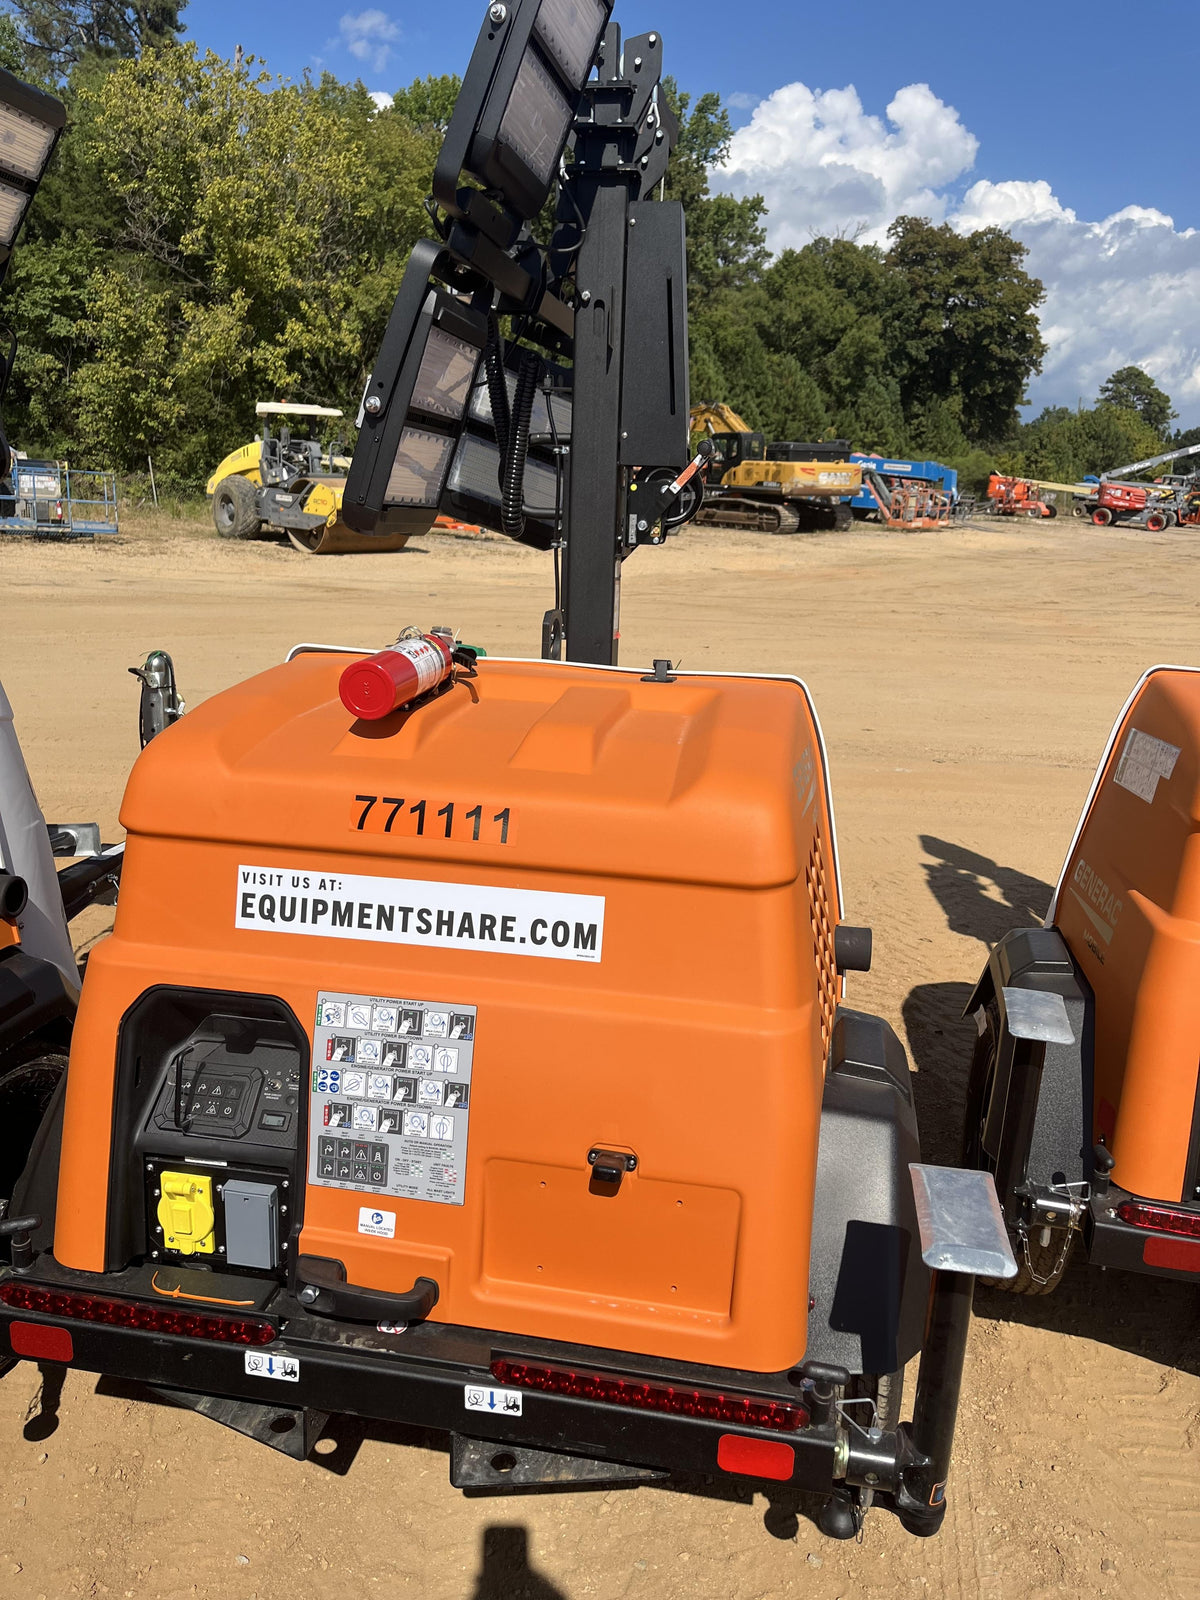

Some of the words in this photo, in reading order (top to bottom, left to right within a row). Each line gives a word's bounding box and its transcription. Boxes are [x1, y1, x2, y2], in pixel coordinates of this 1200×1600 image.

[355, 795, 511, 844] 771111
[242, 871, 284, 888] VISIT
[291, 875, 311, 890] US
[318, 878, 343, 892] AT:
[1074, 859, 1123, 927] GENERAC
[240, 892, 598, 951] EQUIPMENTSHARE.COM
[351, 1064, 394, 1072] ENGINE/GENERATOR
